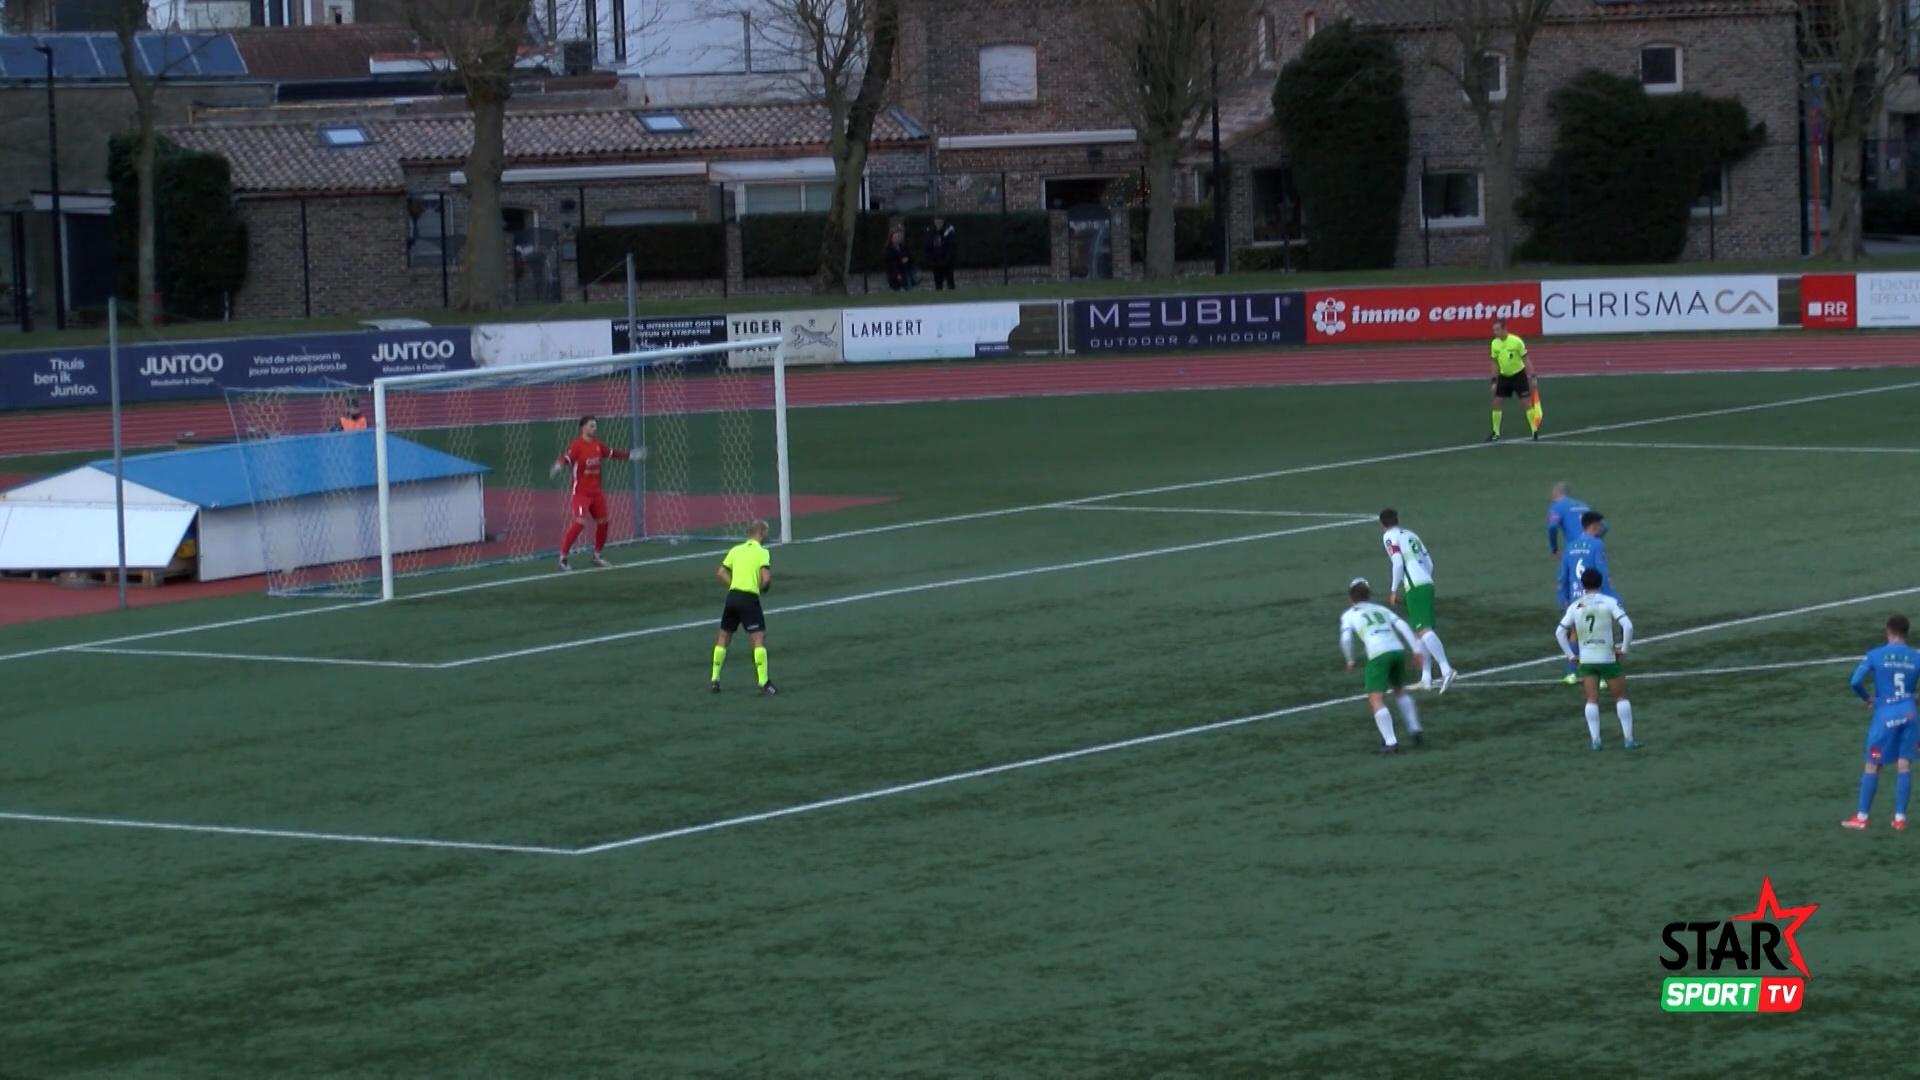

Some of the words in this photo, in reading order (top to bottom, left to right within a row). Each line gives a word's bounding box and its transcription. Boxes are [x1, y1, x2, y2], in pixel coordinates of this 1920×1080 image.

[1090, 297, 1281, 328] MEUBILI
[1351, 305, 1420, 324] immo
[1429, 299, 1535, 321] centrale
[1545, 290, 1709, 318] CHRISMA
[1824, 301, 1848, 316] RR
[733, 320, 782, 335] TIGER
[851, 319, 923, 338] LAMBERT
[1090, 336, 1178, 348] OUTDOOR
[1189, 335, 1198, 344] &
[1209, 331, 1281, 343] INDOOR
[254, 355, 273, 364] Vind
[274, 355, 286, 364] de
[287, 353, 331, 363] showroom
[332, 352, 341, 361] in
[372, 340, 455, 362] JUNTOO
[50, 357, 84, 371] Thuis
[140, 353, 223, 376] JUNTOO
[249, 367, 270, 378] jouw
[270, 365, 294, 375] buurt
[295, 364, 307, 375] op
[34, 373, 58, 385] ben
[59, 371, 71, 383] ik
[51, 384, 98, 398] Juntoo.
[1585, 614, 1595, 634] 7
[1893, 673, 1905, 697] 5
